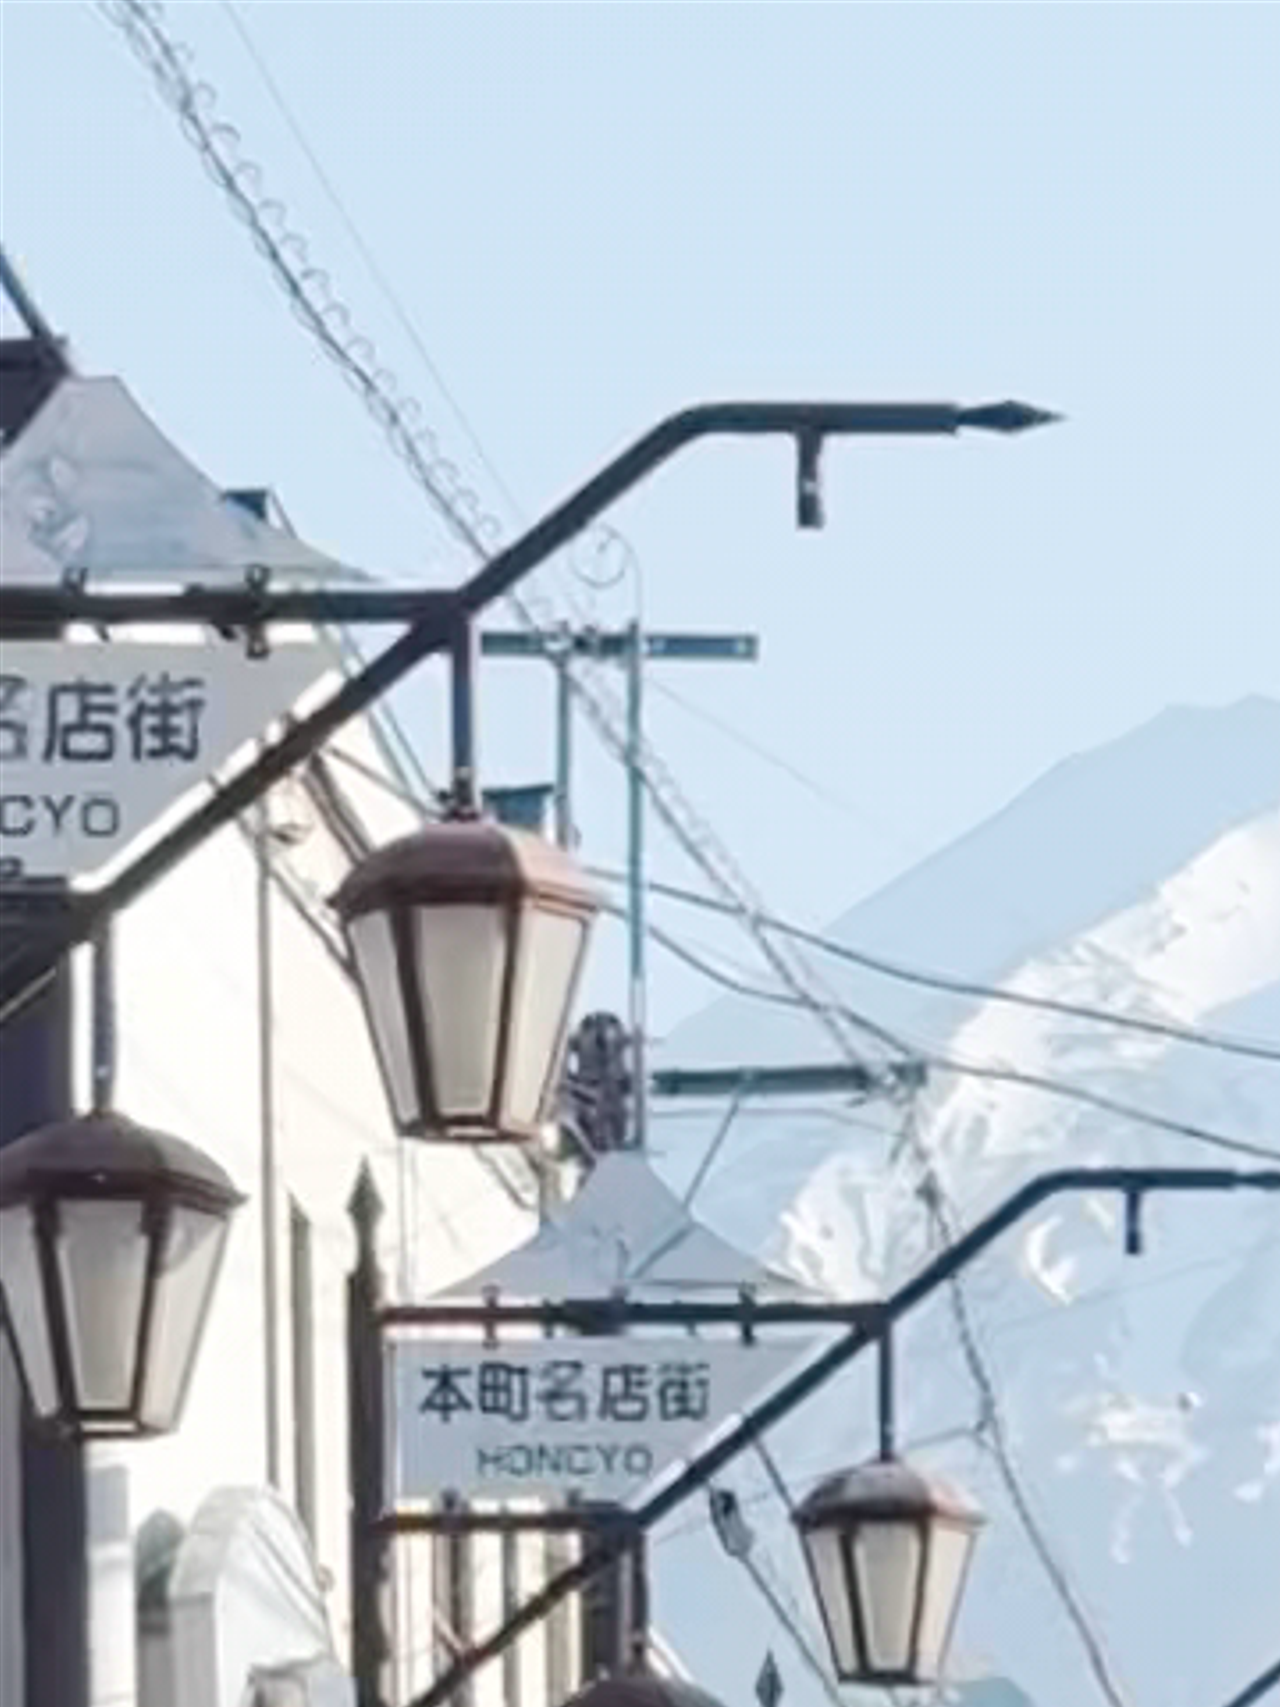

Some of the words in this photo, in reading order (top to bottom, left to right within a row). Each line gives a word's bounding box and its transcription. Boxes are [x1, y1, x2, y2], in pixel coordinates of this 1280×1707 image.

[418, 1359, 710, 1423] 本町名店街
[475, 1444, 655, 1477] HONCYO
